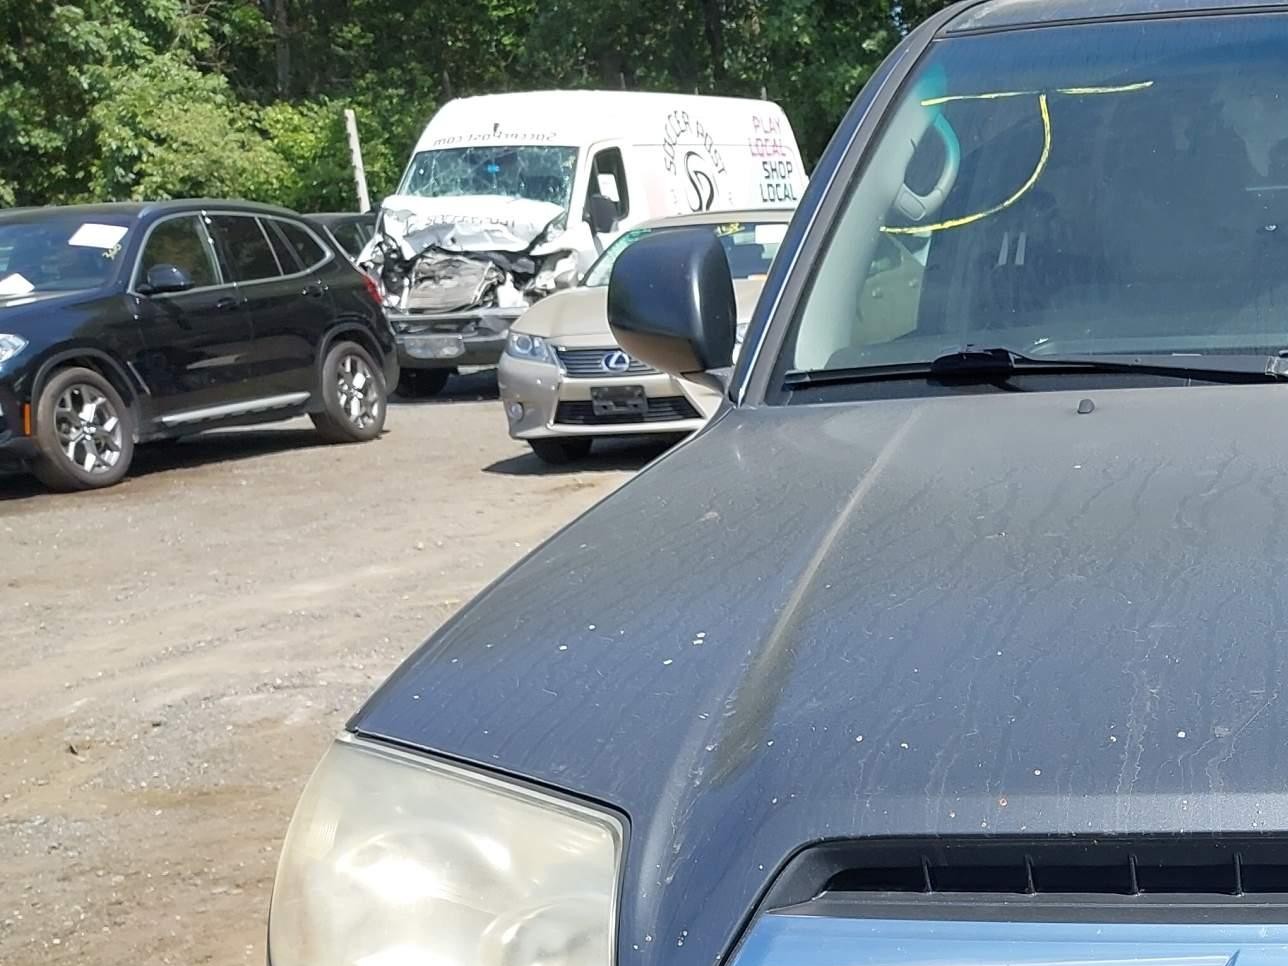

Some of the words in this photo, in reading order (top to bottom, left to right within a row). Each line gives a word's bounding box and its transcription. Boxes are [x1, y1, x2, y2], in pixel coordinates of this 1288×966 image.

[752, 115, 781, 134] PLAY
[662, 110, 693, 176] SOCCER
[696, 119, 728, 175] POST
[748, 138, 787, 157] LOCAL
[762, 160, 793, 179] SHOP
[760, 183, 798, 203] LOCAL
